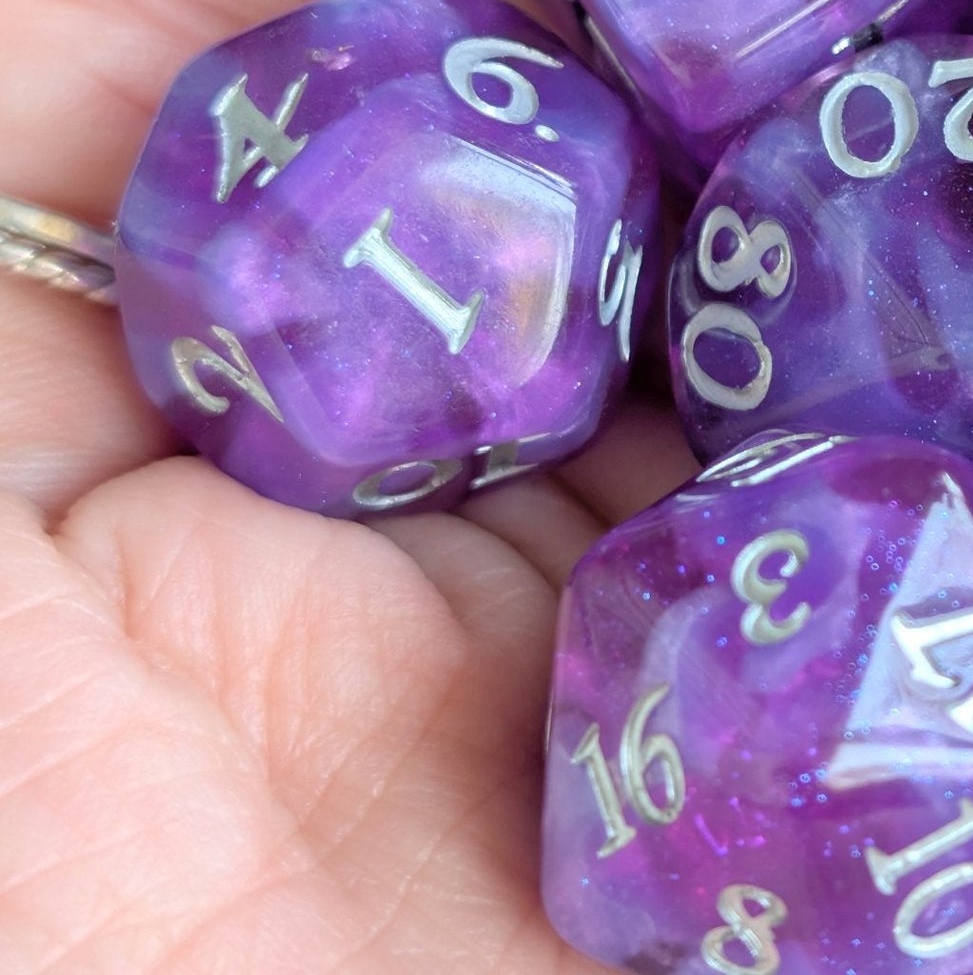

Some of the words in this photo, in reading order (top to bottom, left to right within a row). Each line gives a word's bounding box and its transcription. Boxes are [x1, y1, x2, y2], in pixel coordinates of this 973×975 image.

[210, 72, 309, 204] 4
[343, 207, 485, 355] 1
[682, 205, 795, 411] 80
[171, 325, 284, 424] 2
[731, 530, 810, 646] 3
[570, 682, 686, 859] 16
[701, 883, 788, 975] 8
